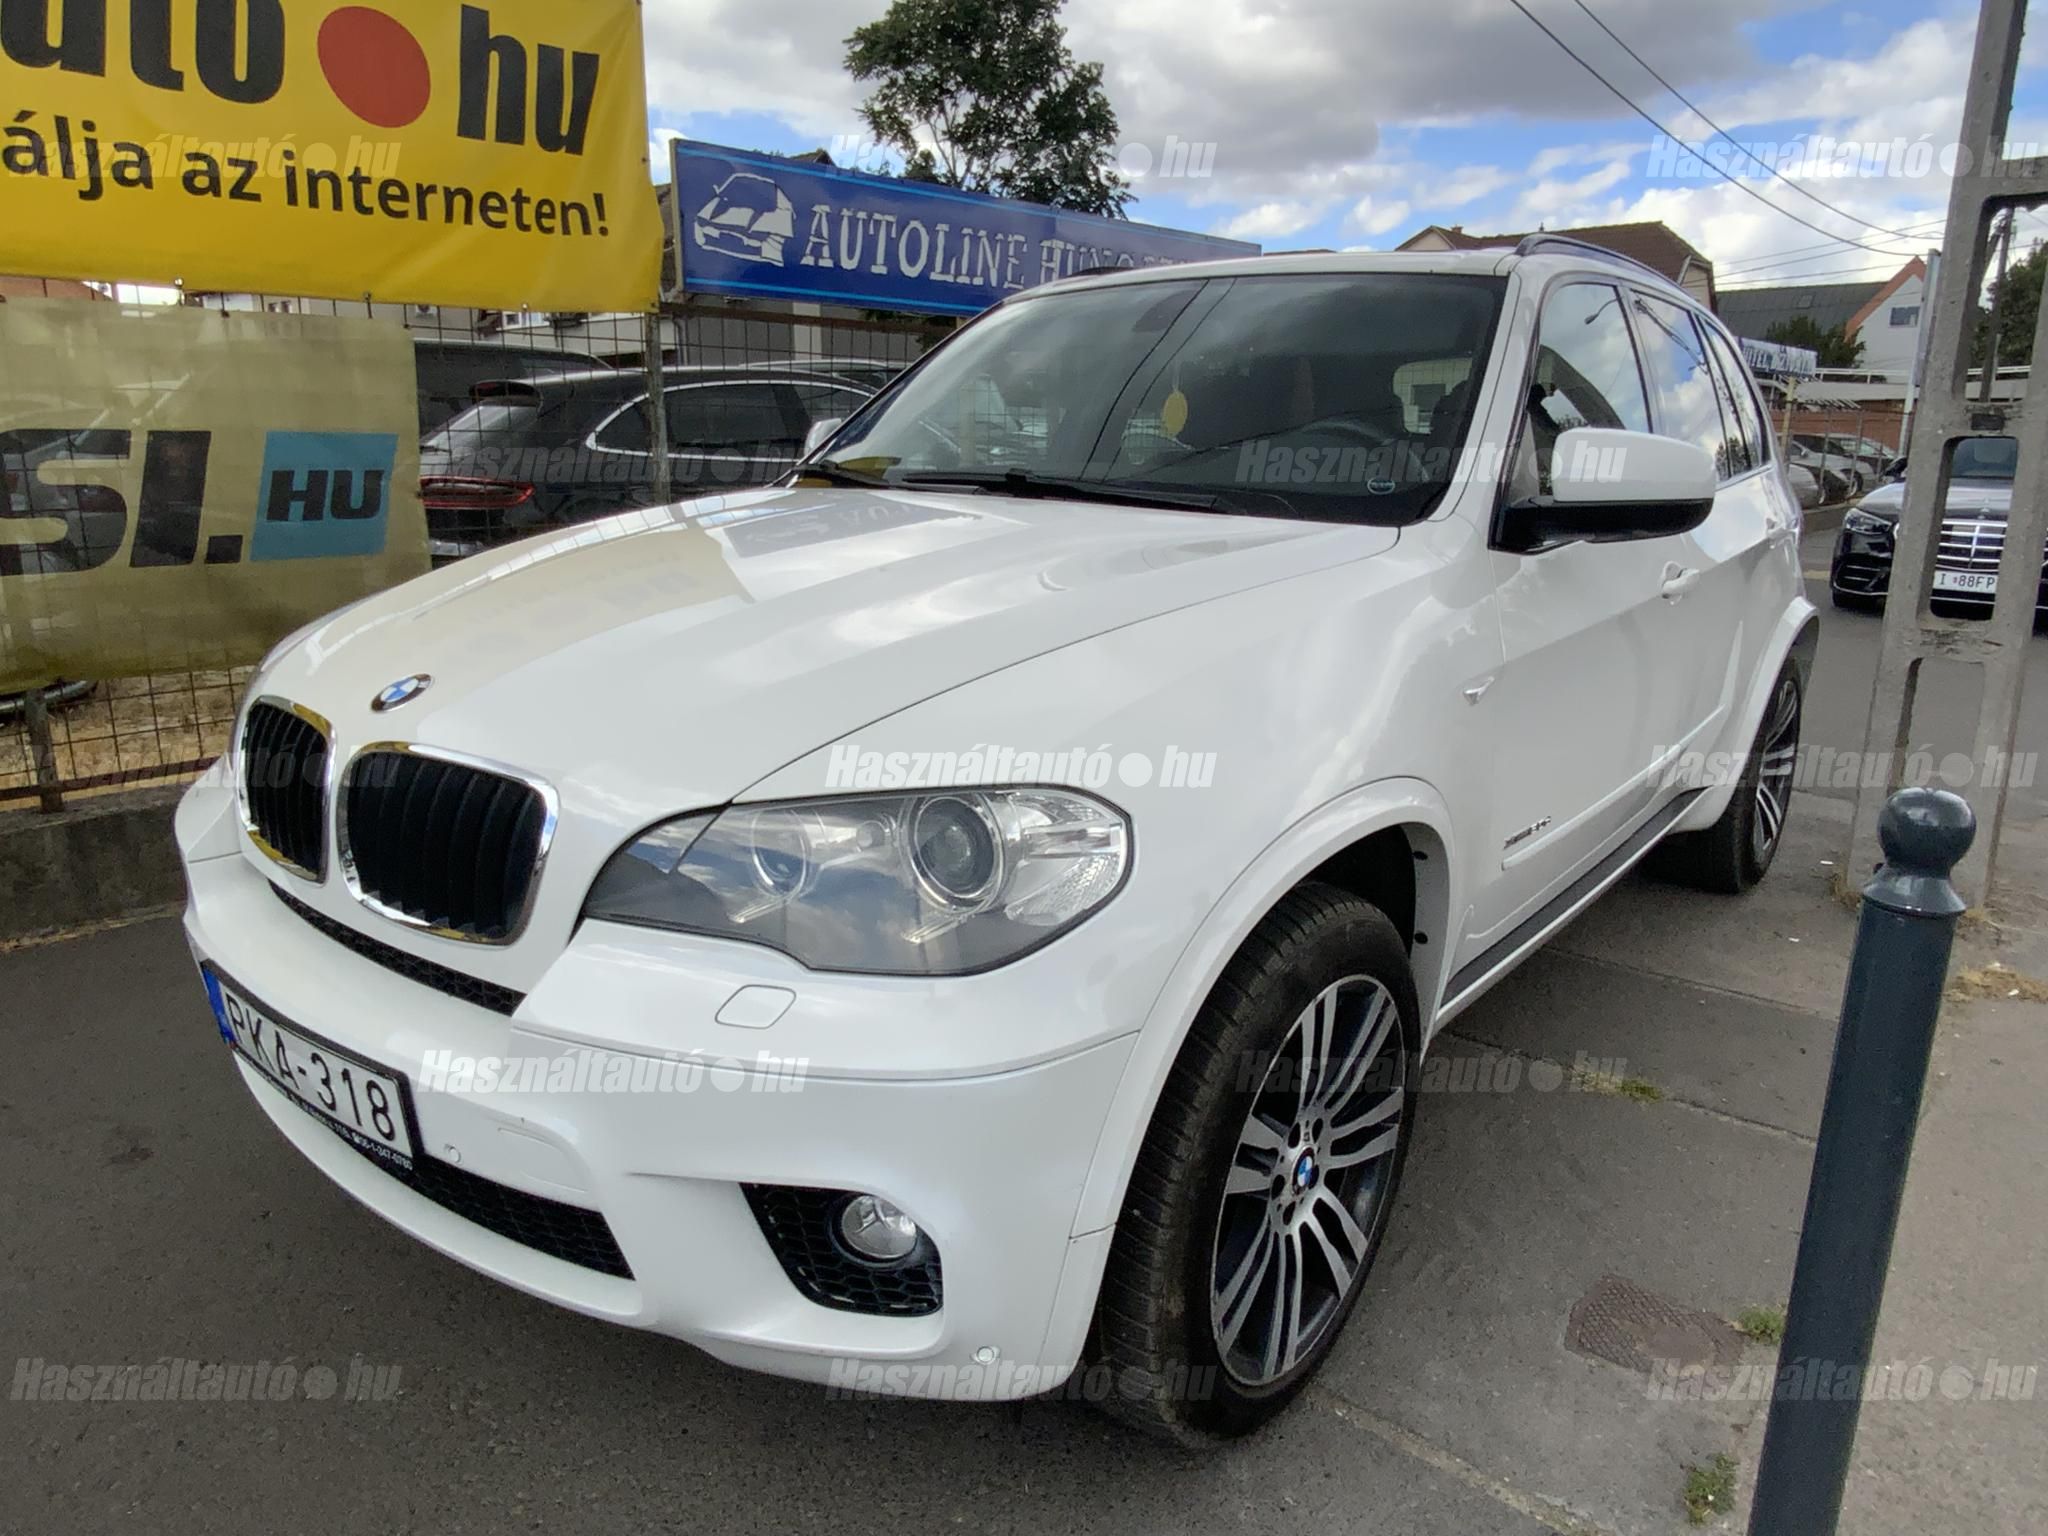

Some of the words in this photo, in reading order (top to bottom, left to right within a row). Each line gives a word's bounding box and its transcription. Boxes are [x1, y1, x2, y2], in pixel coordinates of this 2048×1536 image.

[3, 110, 154, 201] álja
[182, 151, 262, 203] az
[283, 149, 609, 237] interneten!
[800, 203, 1028, 290] AUTOLINE
[225, 991, 396, 1142] PKA-318
